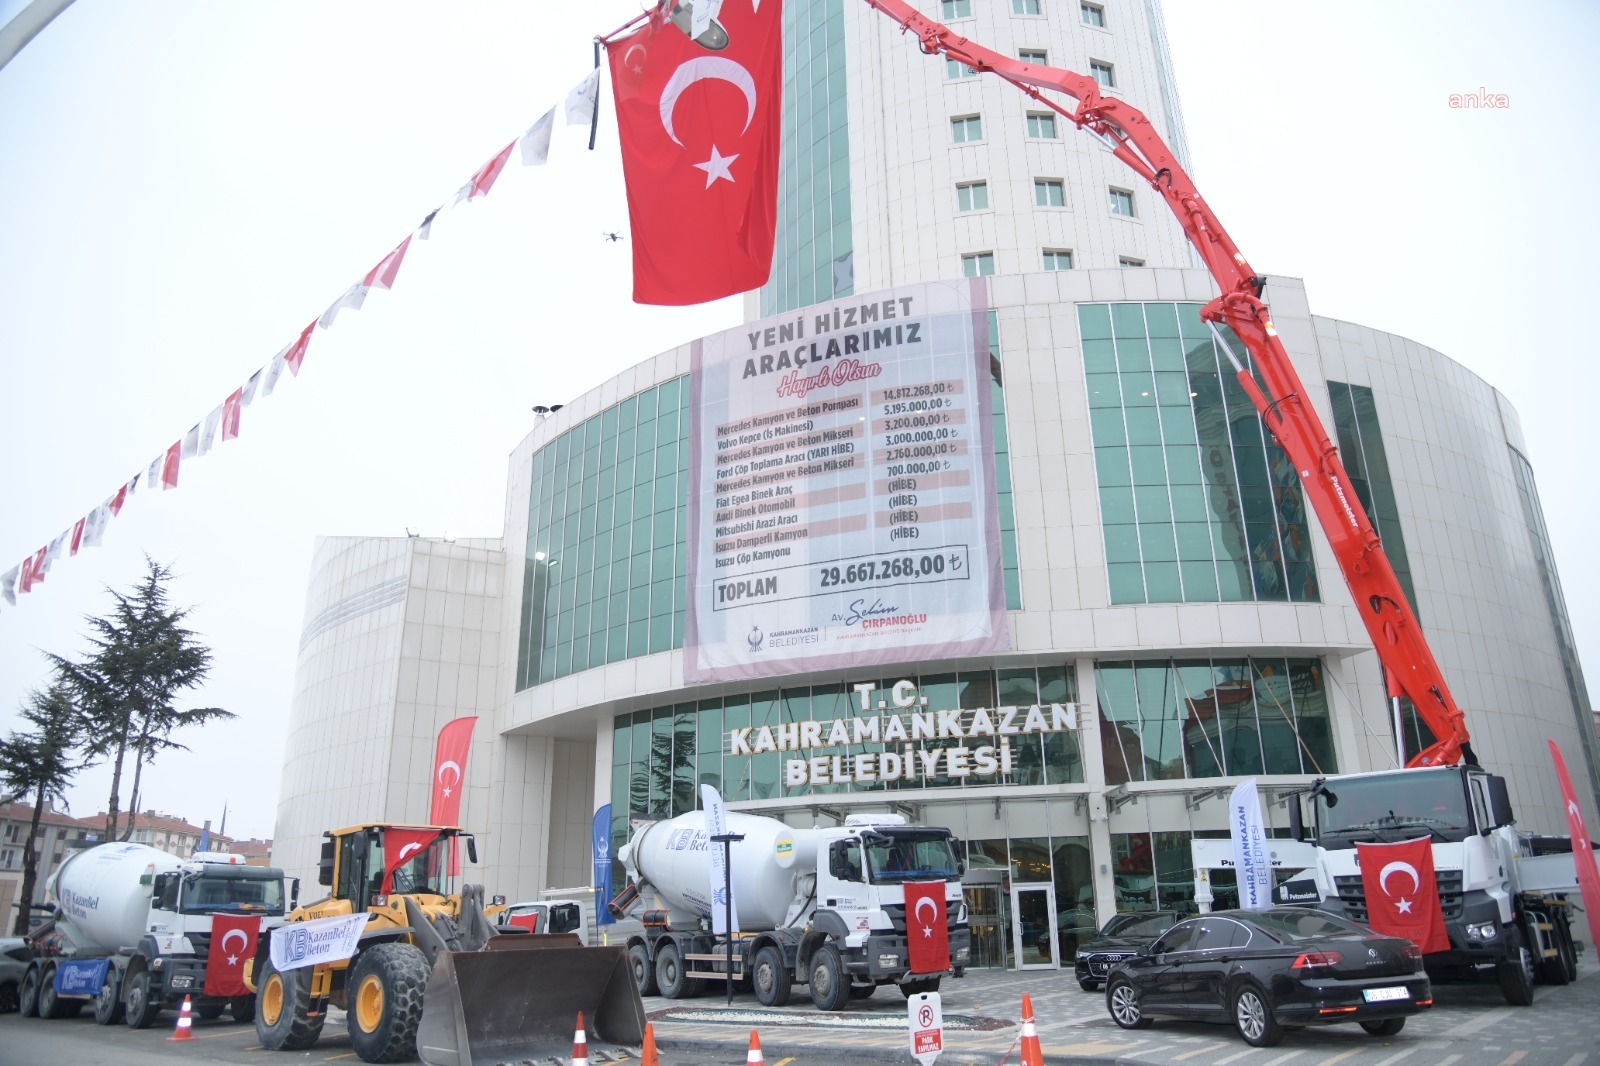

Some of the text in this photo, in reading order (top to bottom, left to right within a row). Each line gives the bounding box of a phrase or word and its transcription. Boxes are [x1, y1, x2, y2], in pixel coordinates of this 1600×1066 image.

[748, 297, 913, 350] YENİ HİZMET
[743, 323, 922, 379] ARAÇLARIMIZ
[832, 359, 882, 386] Olsun
[884, 383, 945, 400] 14.812.268,00
[718, 398, 859, 437] Mercedes Kamyon ve Beton Pompası
[884, 398, 942, 415] 5.195.000,00
[885, 414, 940, 430] 3.200.00,00
[717, 420, 814, 451] Volvo Kepçe (İş Makinesi)
[717, 427, 854, 465] Mercedes Kamyon ve Beton Mikseri
[886, 428, 948, 446] 3.000.000,00
[716, 442, 854, 480] Ford Çöp Toplama Aracı (YARI HİBE)
[887, 460, 940, 477] 700.000,00
[716, 457, 854, 494] Mercedes Kamyon ve Beton Mikseri
[888, 478, 916, 494] (HİBE)
[716, 485, 793, 508] Fiat Egea Binek Araç
[888, 494, 918, 510] (HİBE)
[1330, 476, 1358, 528] Putzmeister
[716, 498, 796, 522] Audi Binek Otomobil
[890, 510, 918, 526] (HİBE)
[716, 514, 798, 538] Mitsubishi Arazi Aracı
[890, 526, 920, 542] (HİBE)
[716, 528, 808, 552] Isuzu Damperli Kamyon
[716, 547, 790, 568] Isuzu Çöp Kamyonu
[820, 554, 945, 587] 29.667.268,00
[718, 576, 778, 602] TOPLAM
[770, 626, 818, 638] KAHRAMANKAZAN
[862, 613, 927, 630] ÇIRPANOĞLU
[769, 634, 819, 648] BELEDİYESİ
[731, 702, 1078, 756] KAHRAMANKAZAN
[786, 736, 1012, 788] BELEDİYESİ
[1238, 806, 1258, 904] KAHRAMANKAZAN
[1248, 824, 1268, 884] BELEDİYESİ
[308, 926, 346, 944] KazanBel
[306, 943, 330, 956] Beton
